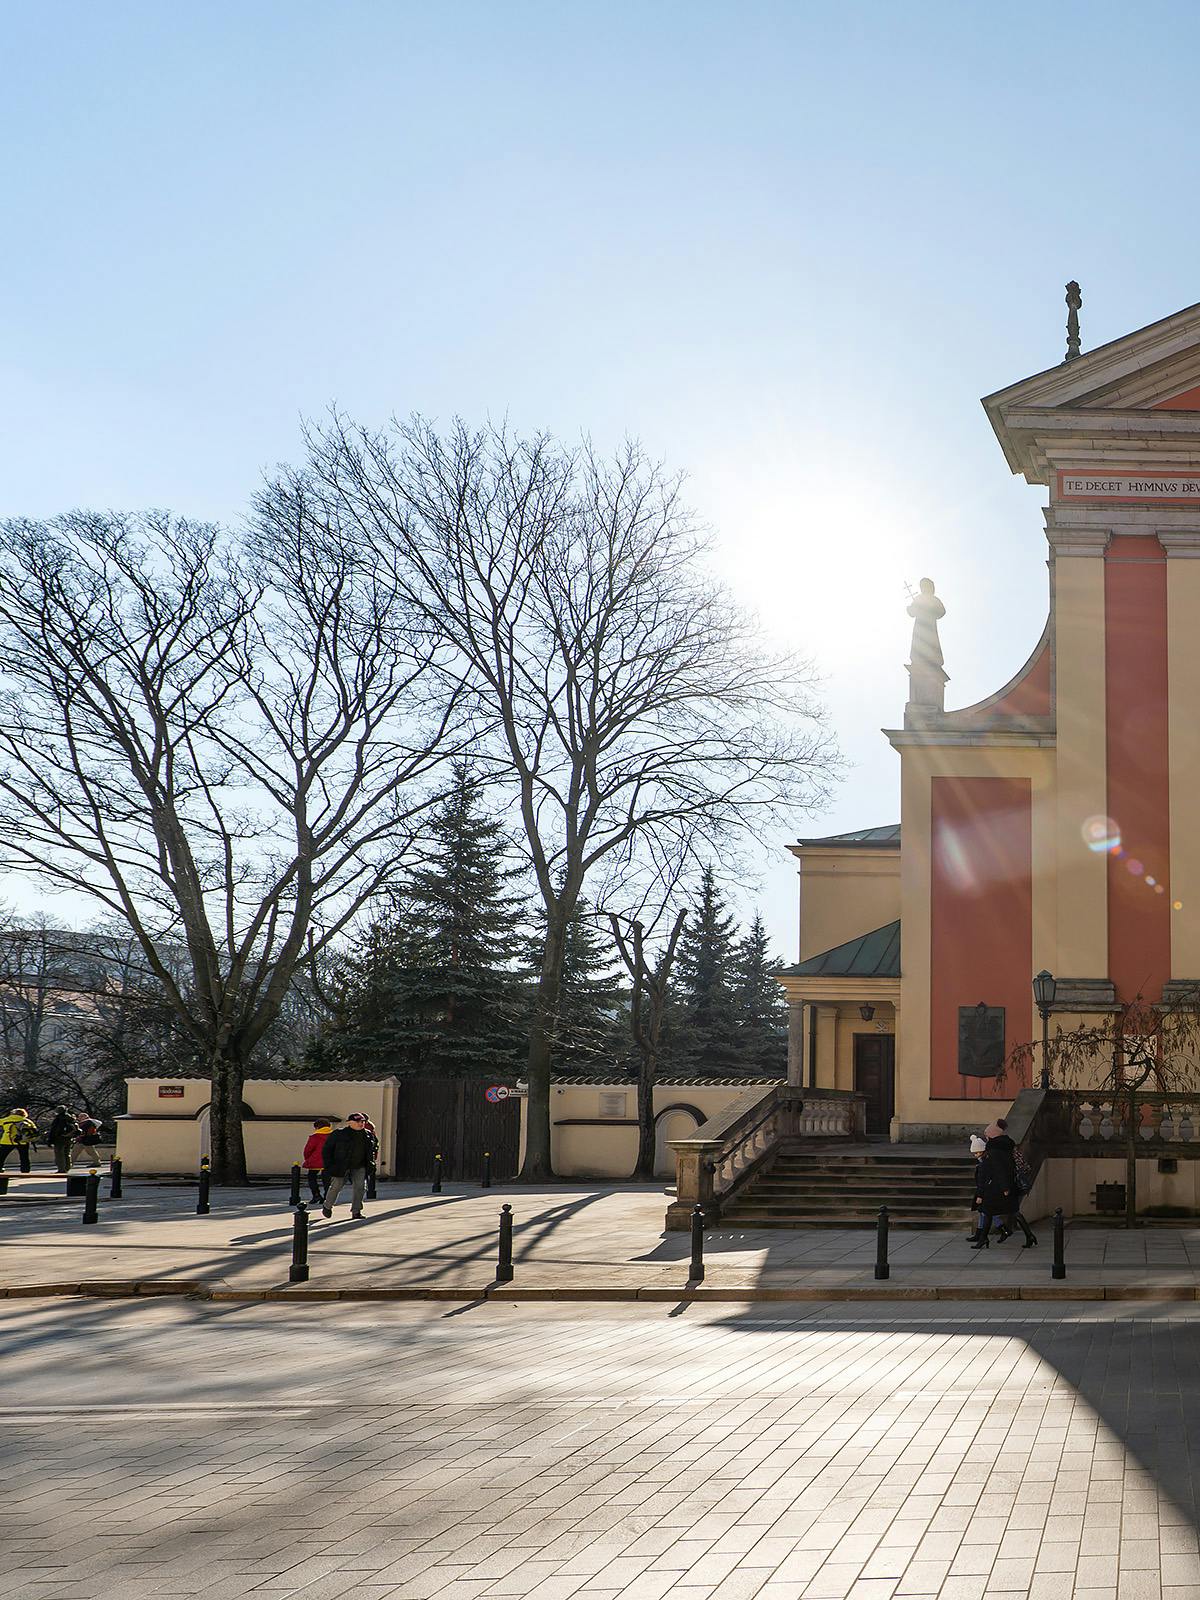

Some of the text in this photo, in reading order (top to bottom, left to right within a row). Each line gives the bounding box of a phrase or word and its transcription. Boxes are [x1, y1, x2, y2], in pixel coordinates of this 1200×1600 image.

[1066, 481, 1083, 491] TE
[1085, 481, 1122, 491] DECET
[1128, 482, 1178, 492] HYMNVS
